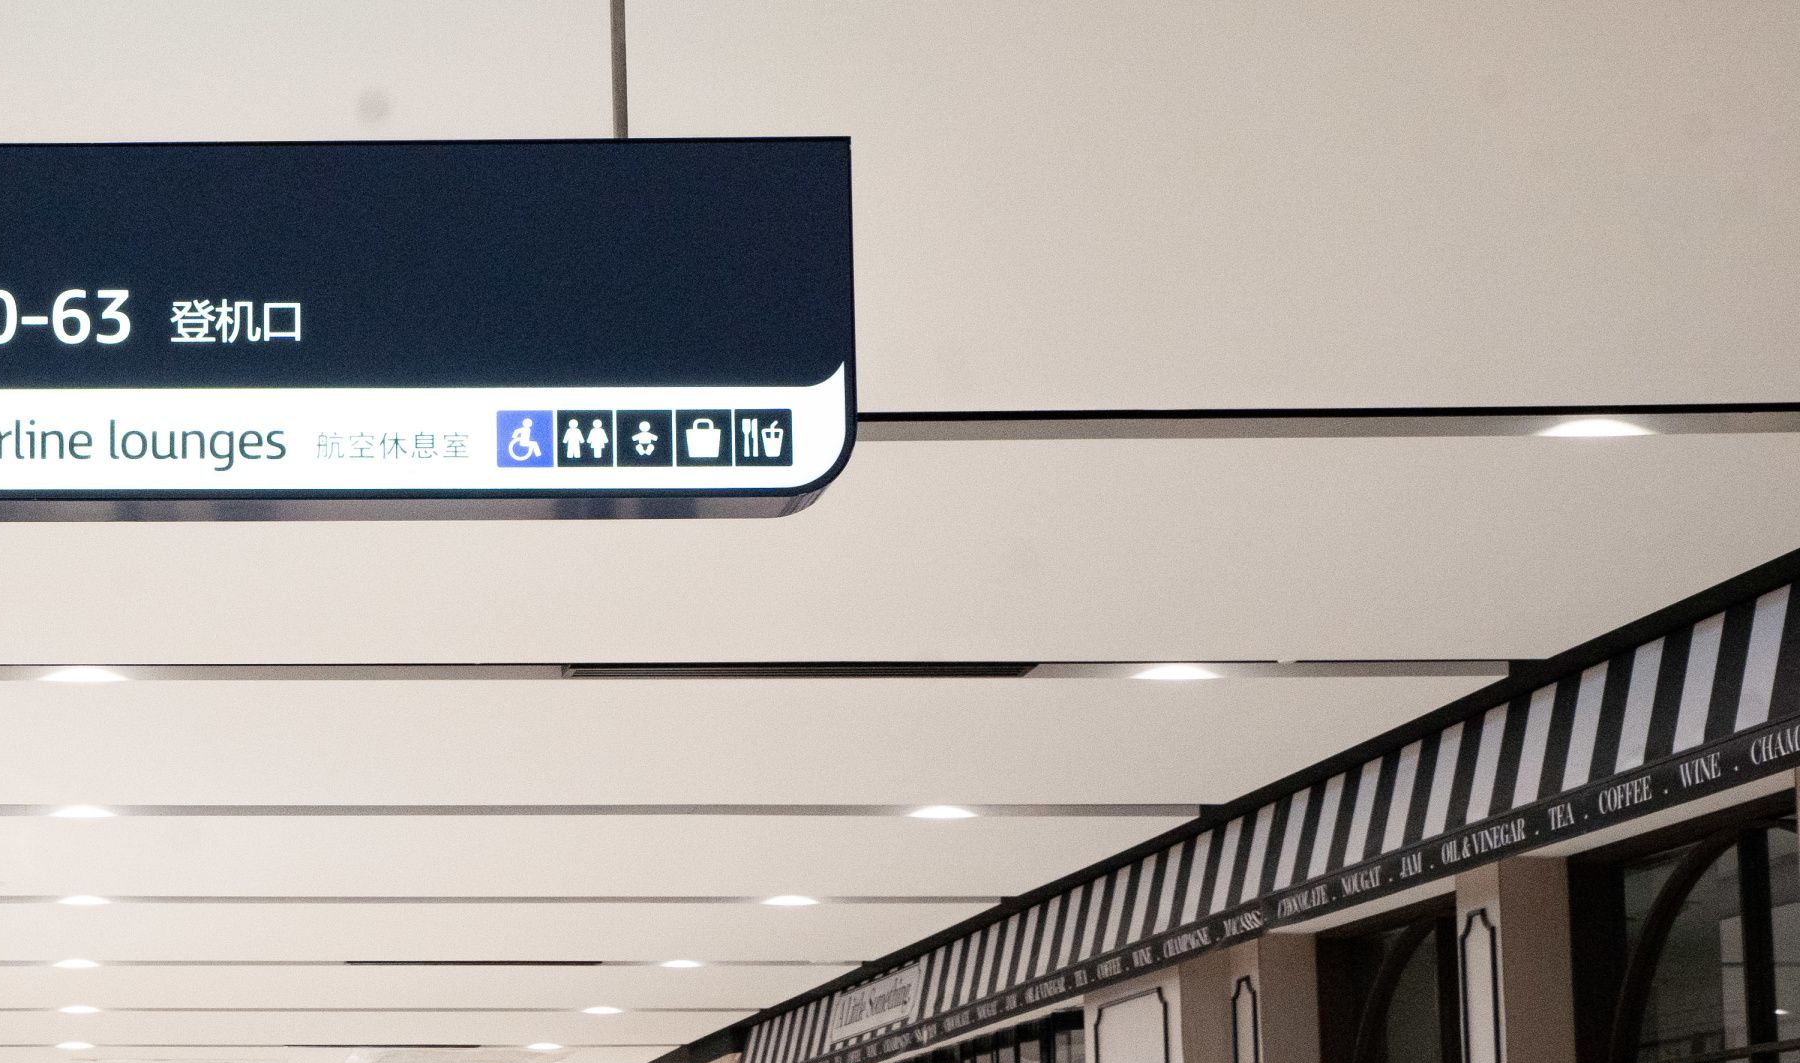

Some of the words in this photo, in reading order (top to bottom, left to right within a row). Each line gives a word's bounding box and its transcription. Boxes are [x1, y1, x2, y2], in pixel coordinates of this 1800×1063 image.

[171, 299, 300, 343] 登机口
[110, 420, 286, 471] lounges
[317, 431, 469, 460] 航空休息室
[1341, 865, 1381, 896] NOUGAT
[1400, 852, 1422, 878] JAM
[1548, 802, 1574, 831] TEA
[1598, 776, 1652, 814] COFFEE
[1679, 752, 1721, 788] WINE
